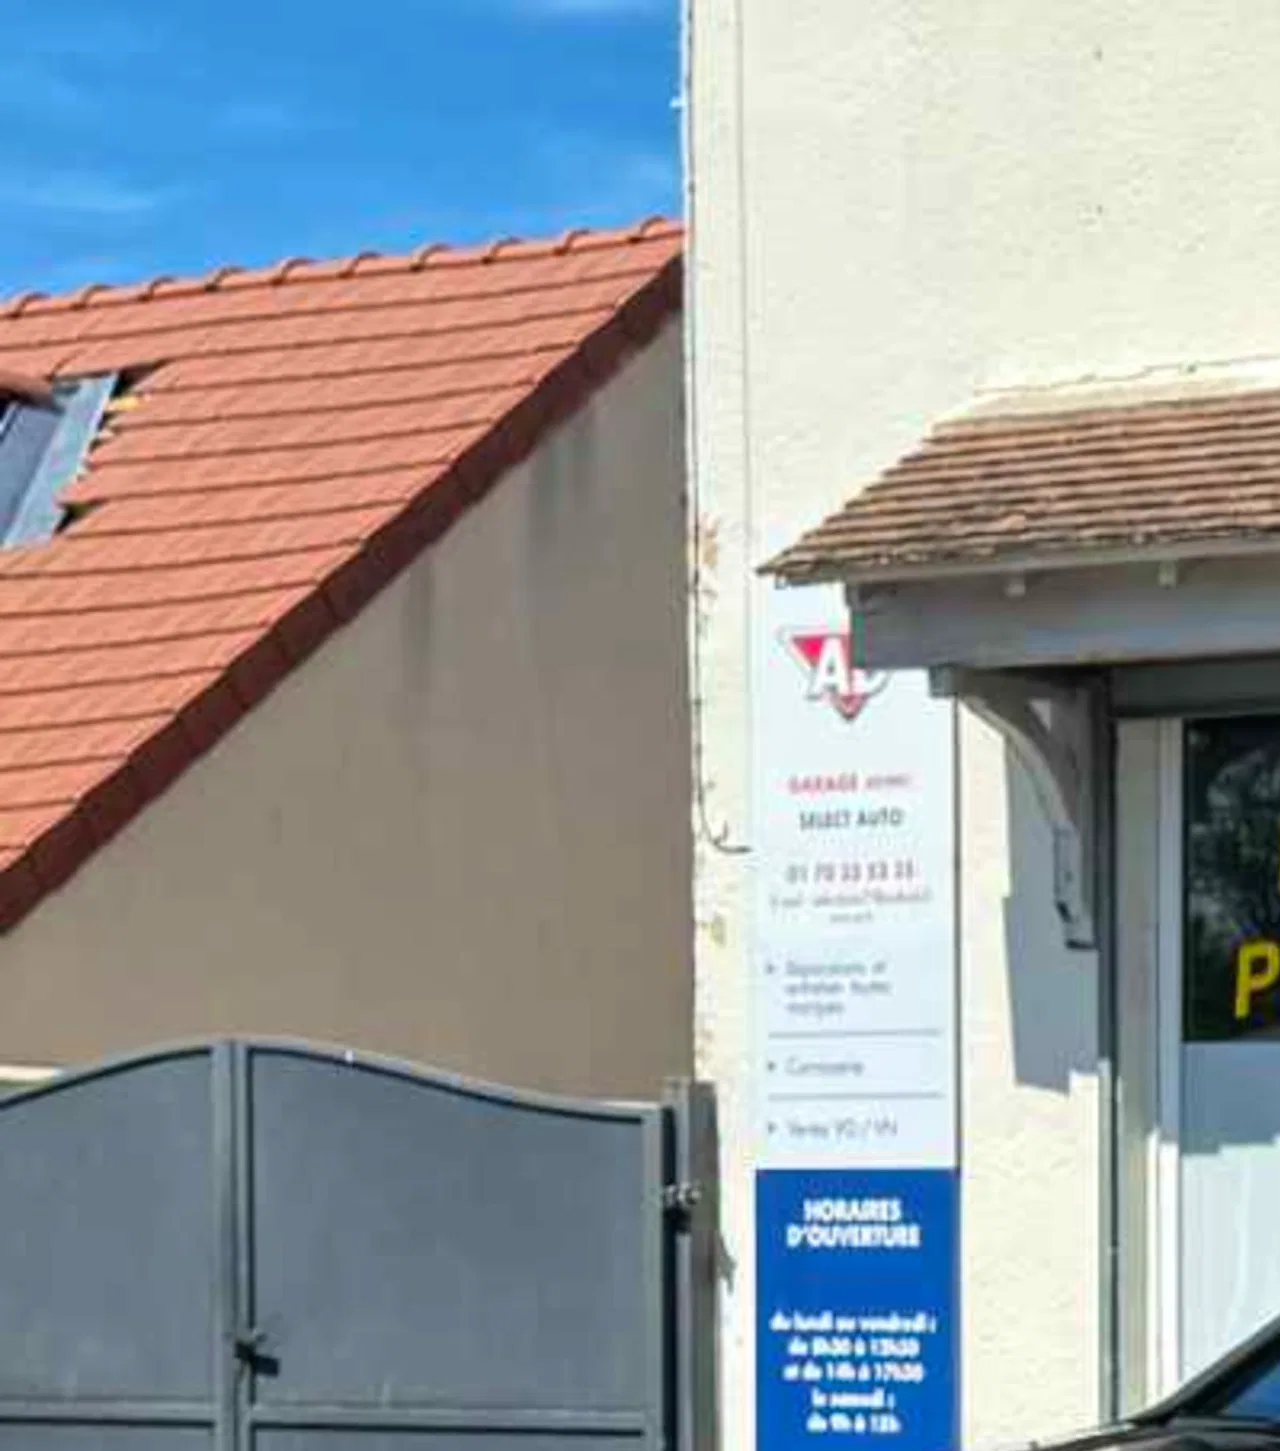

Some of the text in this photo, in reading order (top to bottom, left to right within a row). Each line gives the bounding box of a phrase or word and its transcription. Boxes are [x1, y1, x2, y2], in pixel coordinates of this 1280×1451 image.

[857, 806, 905, 829] AUTO
[803, 1199, 902, 1223] HORAIRES
[786, 1223, 922, 1249] D'OUVERTURE
